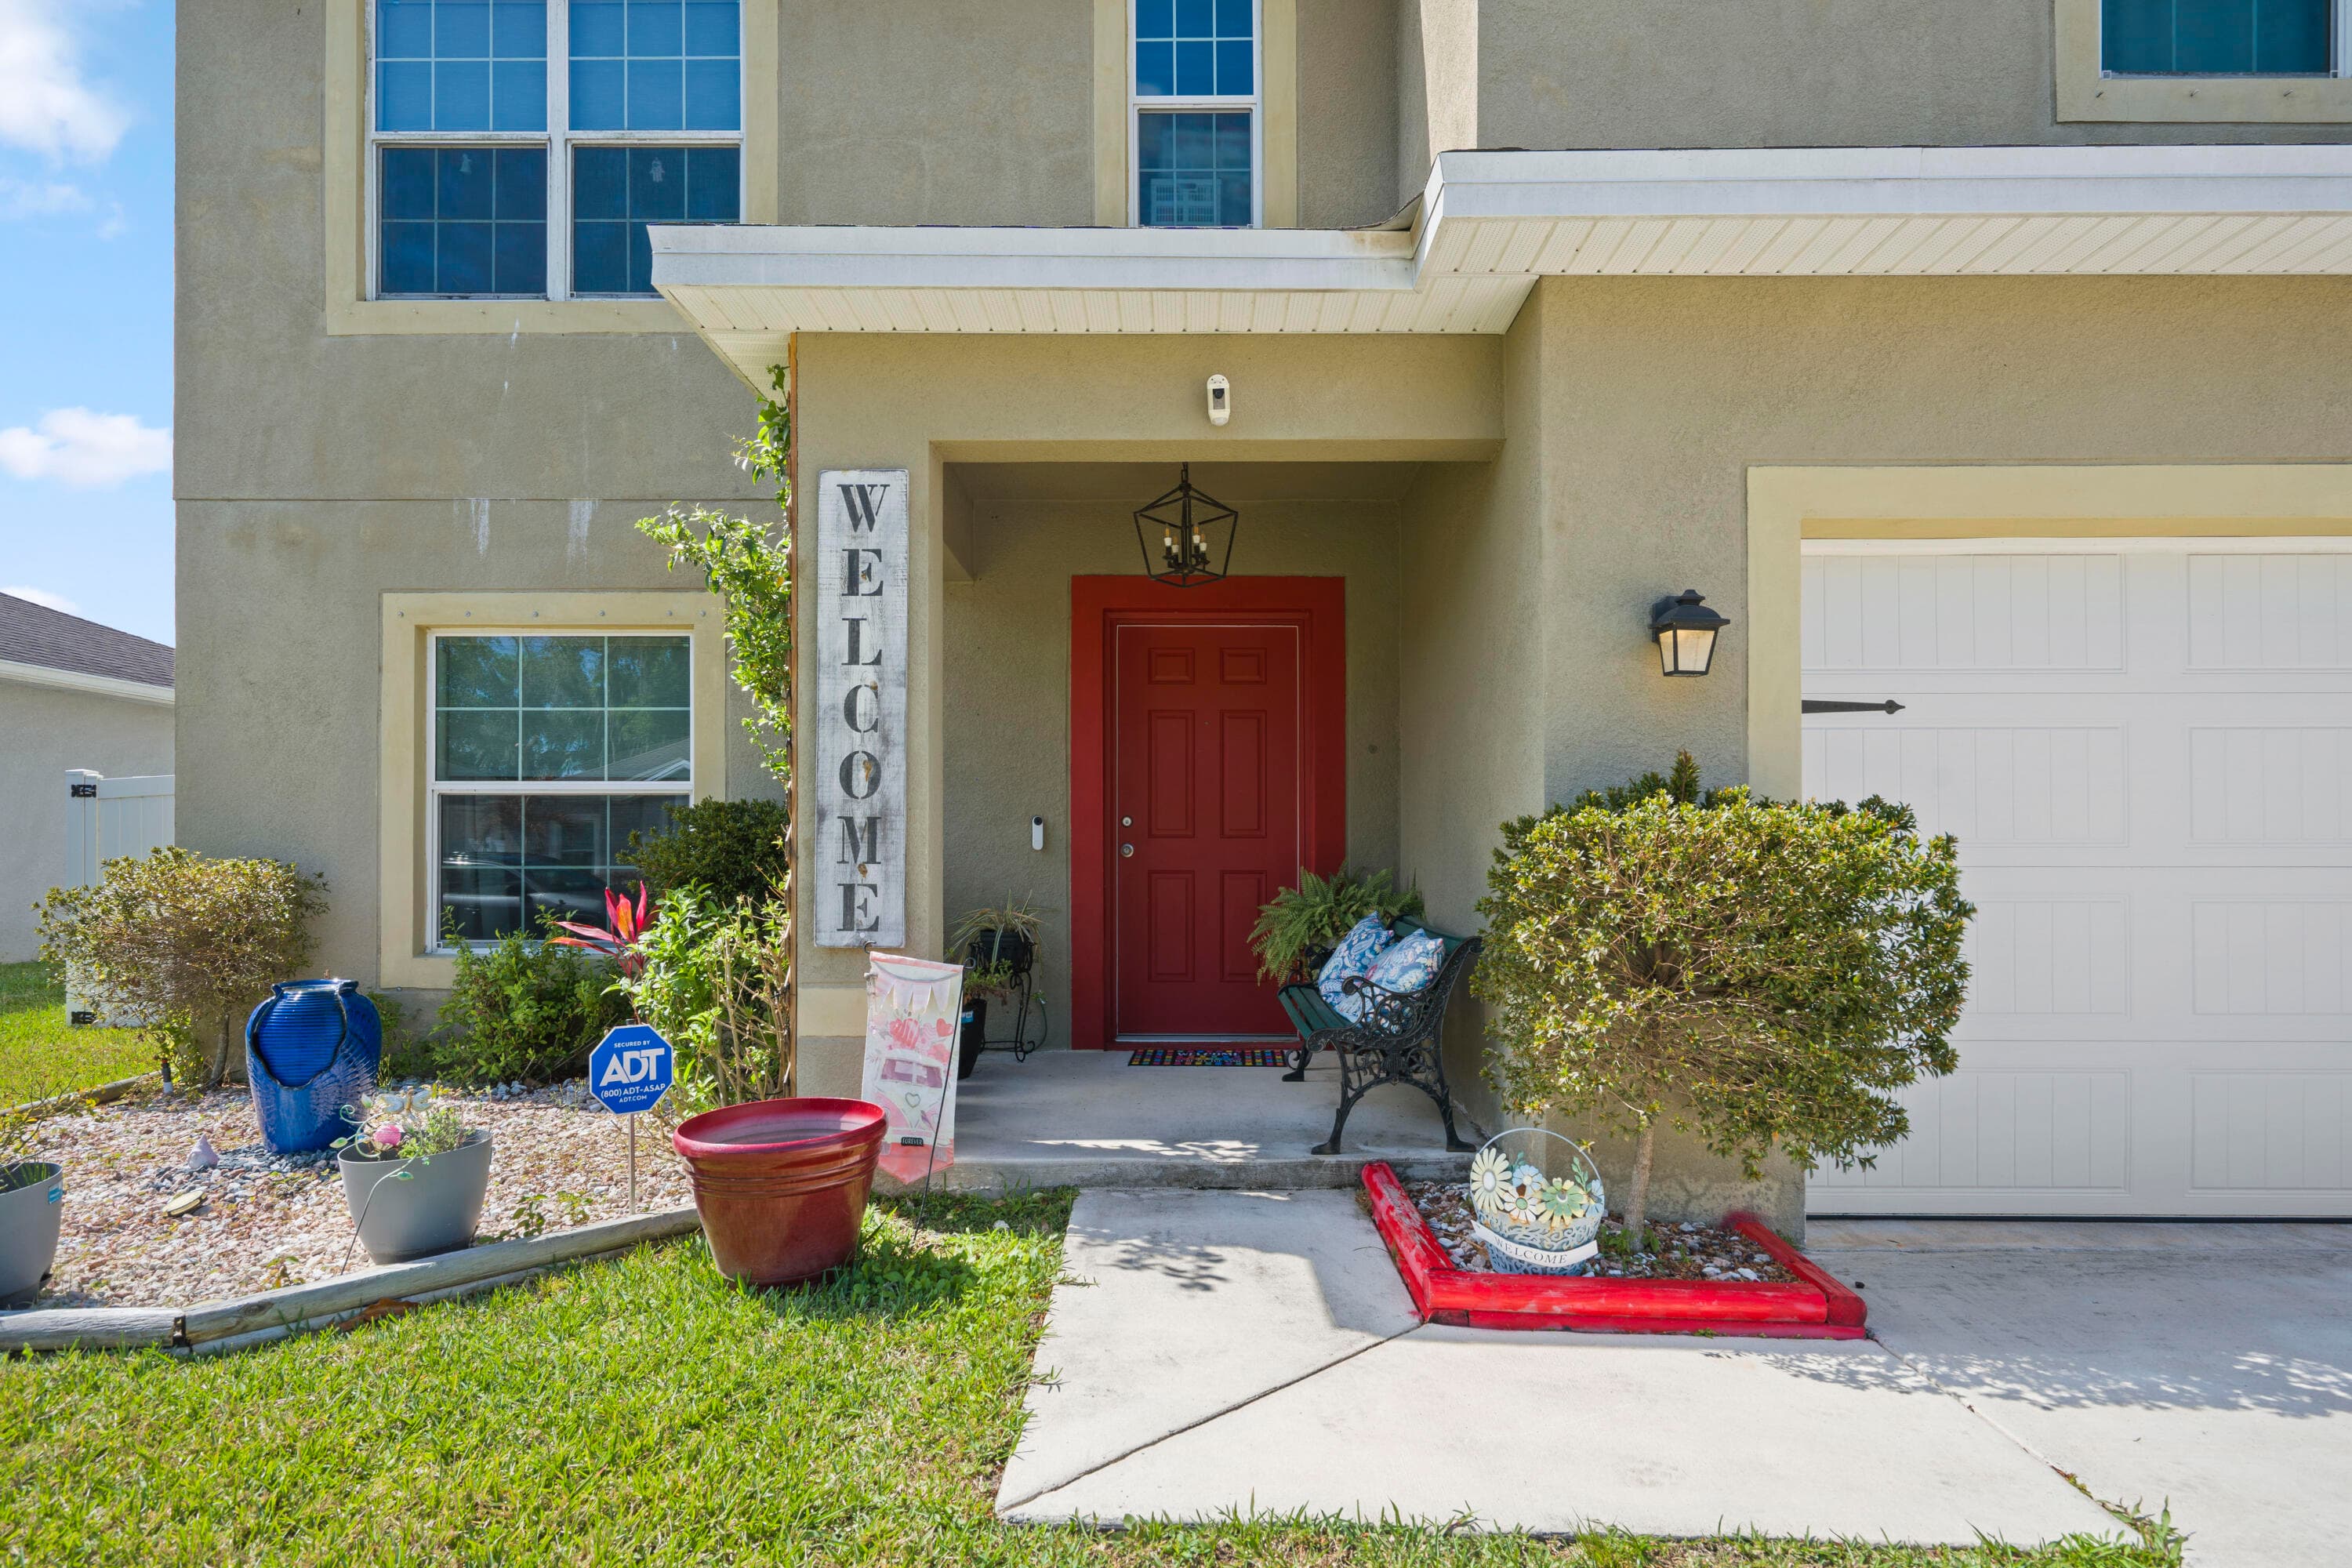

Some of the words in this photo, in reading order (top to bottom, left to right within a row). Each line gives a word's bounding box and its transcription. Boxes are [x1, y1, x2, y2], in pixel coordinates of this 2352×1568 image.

[837, 484, 890, 932] WELCOME
[599, 1047, 665, 1087] ADT
[601, 1087, 622, 1099] (800)
[622, 1083, 666, 1095] ADT-ASAP
[619, 1094, 648, 1103] ADT.COM
[1494, 1236, 1568, 1265] WELCOME
